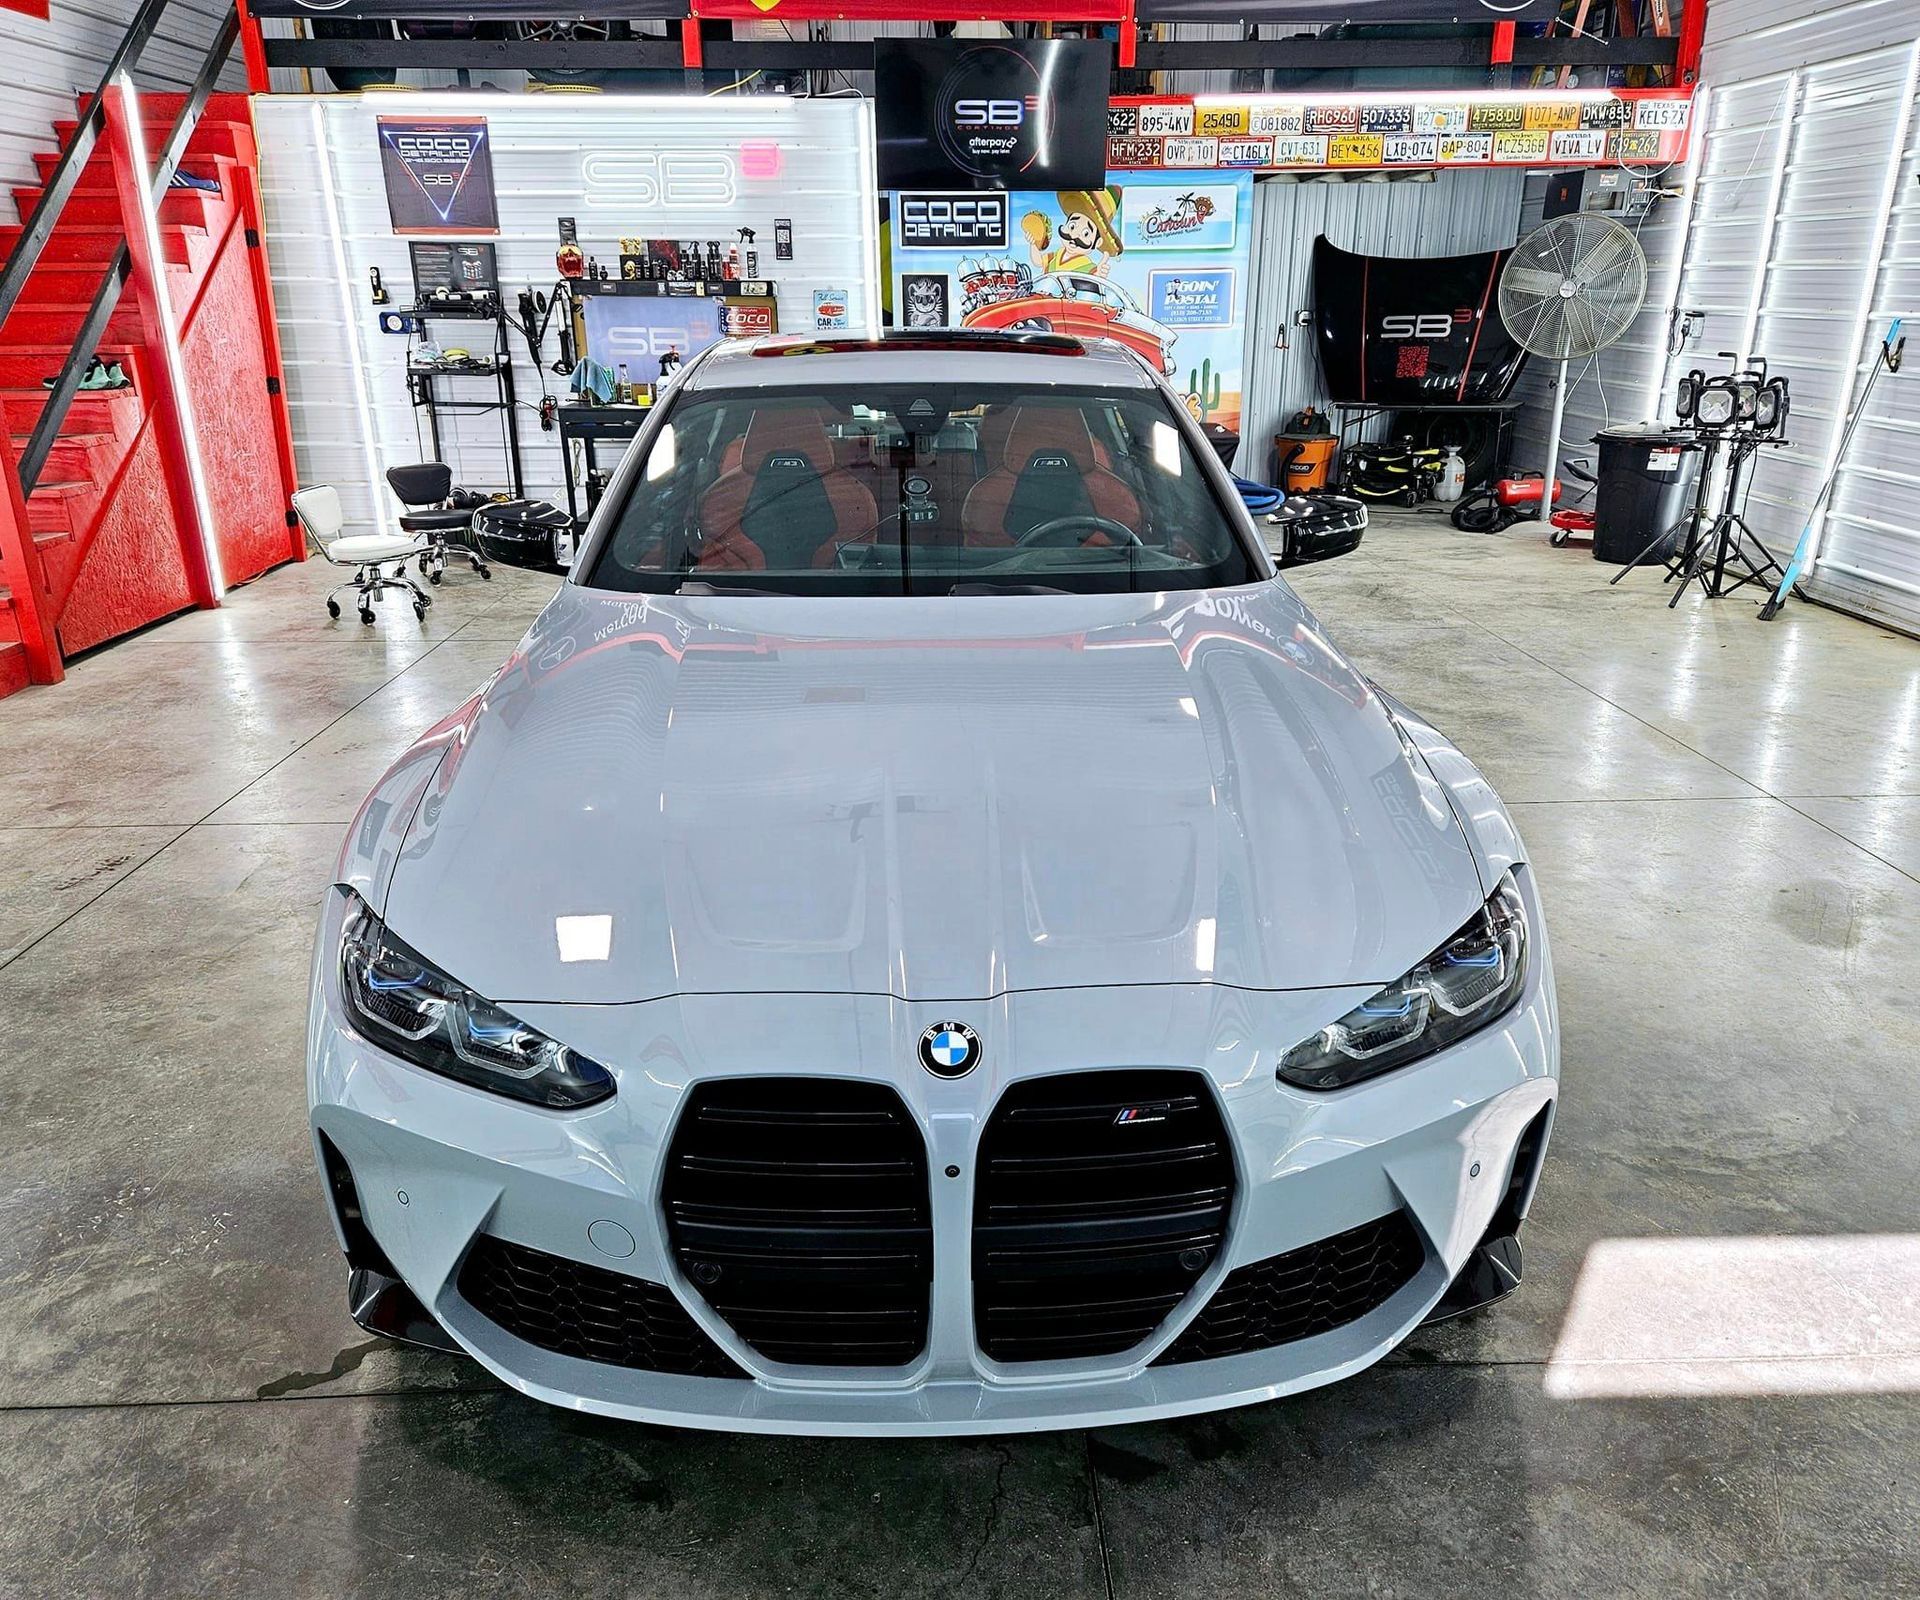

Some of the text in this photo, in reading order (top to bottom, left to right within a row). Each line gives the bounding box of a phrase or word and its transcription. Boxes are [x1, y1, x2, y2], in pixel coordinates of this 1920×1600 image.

[1203, 113, 1240, 129] 25490
[1309, 110, 1356, 124] RHG960
[398, 138, 470, 150] COCO
[969, 137, 1007, 148] afterpay
[1555, 139, 1602, 155] VIVA LV
[1638, 138, 1657, 153] 262
[1167, 145, 1214, 160] OVR 101
[1233, 145, 1271, 160] CT46LX
[1331, 144, 1379, 158] BEY 456
[903, 201, 1001, 223] COCO
[905, 223, 1002, 237] DETAILING
[1164, 293, 1219, 305] POSTAL
[726, 313, 768, 324] COCO
[817, 317, 832, 327] CAR
